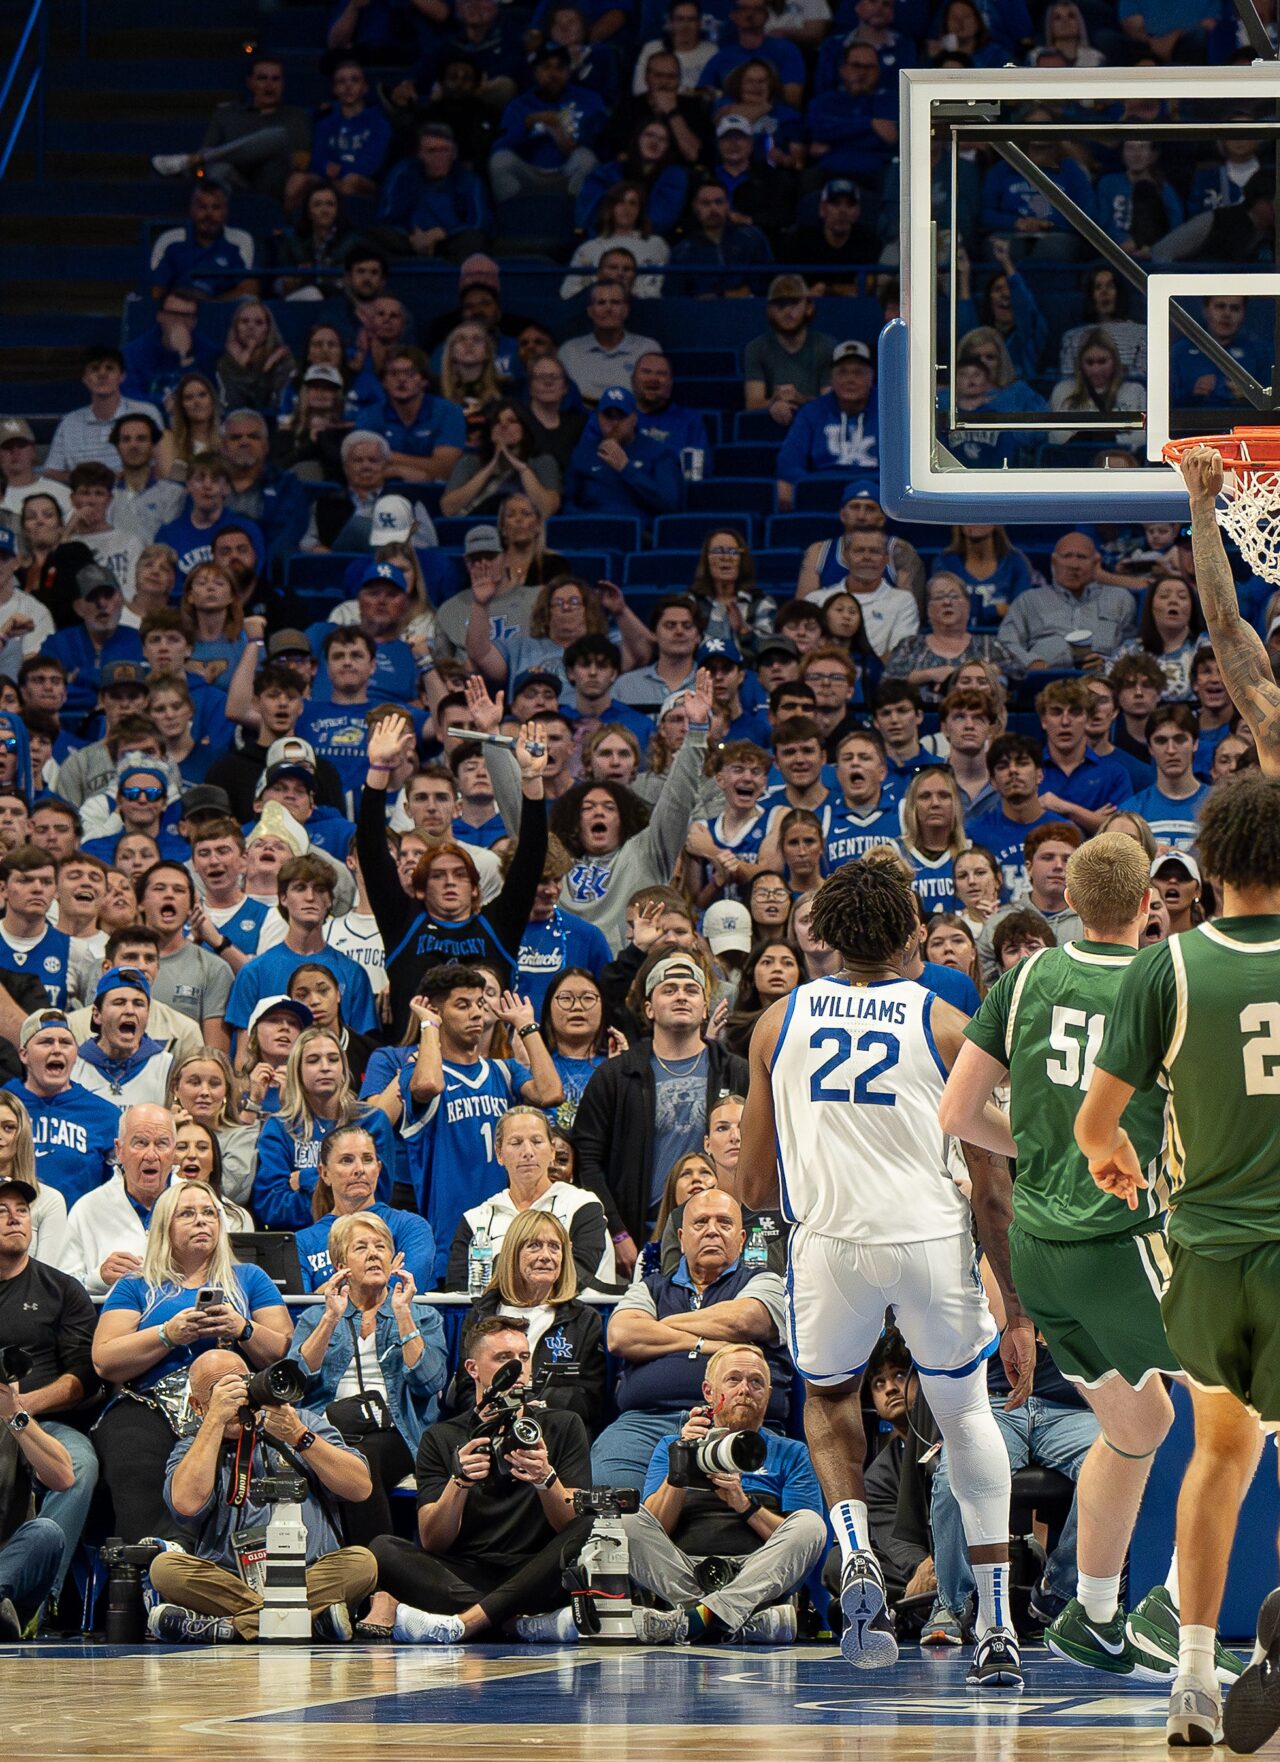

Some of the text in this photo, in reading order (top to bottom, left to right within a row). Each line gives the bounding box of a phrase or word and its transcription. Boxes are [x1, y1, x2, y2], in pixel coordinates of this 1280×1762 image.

[810, 995, 907, 1026] WILLIAMS
[1046, 1005, 1106, 1092] 51
[810, 1028, 901, 1107] 22
[481, 1121, 494, 1164] 1
[235, 1473, 247, 1505] Canon
[574, 1597, 583, 1624] Canon
